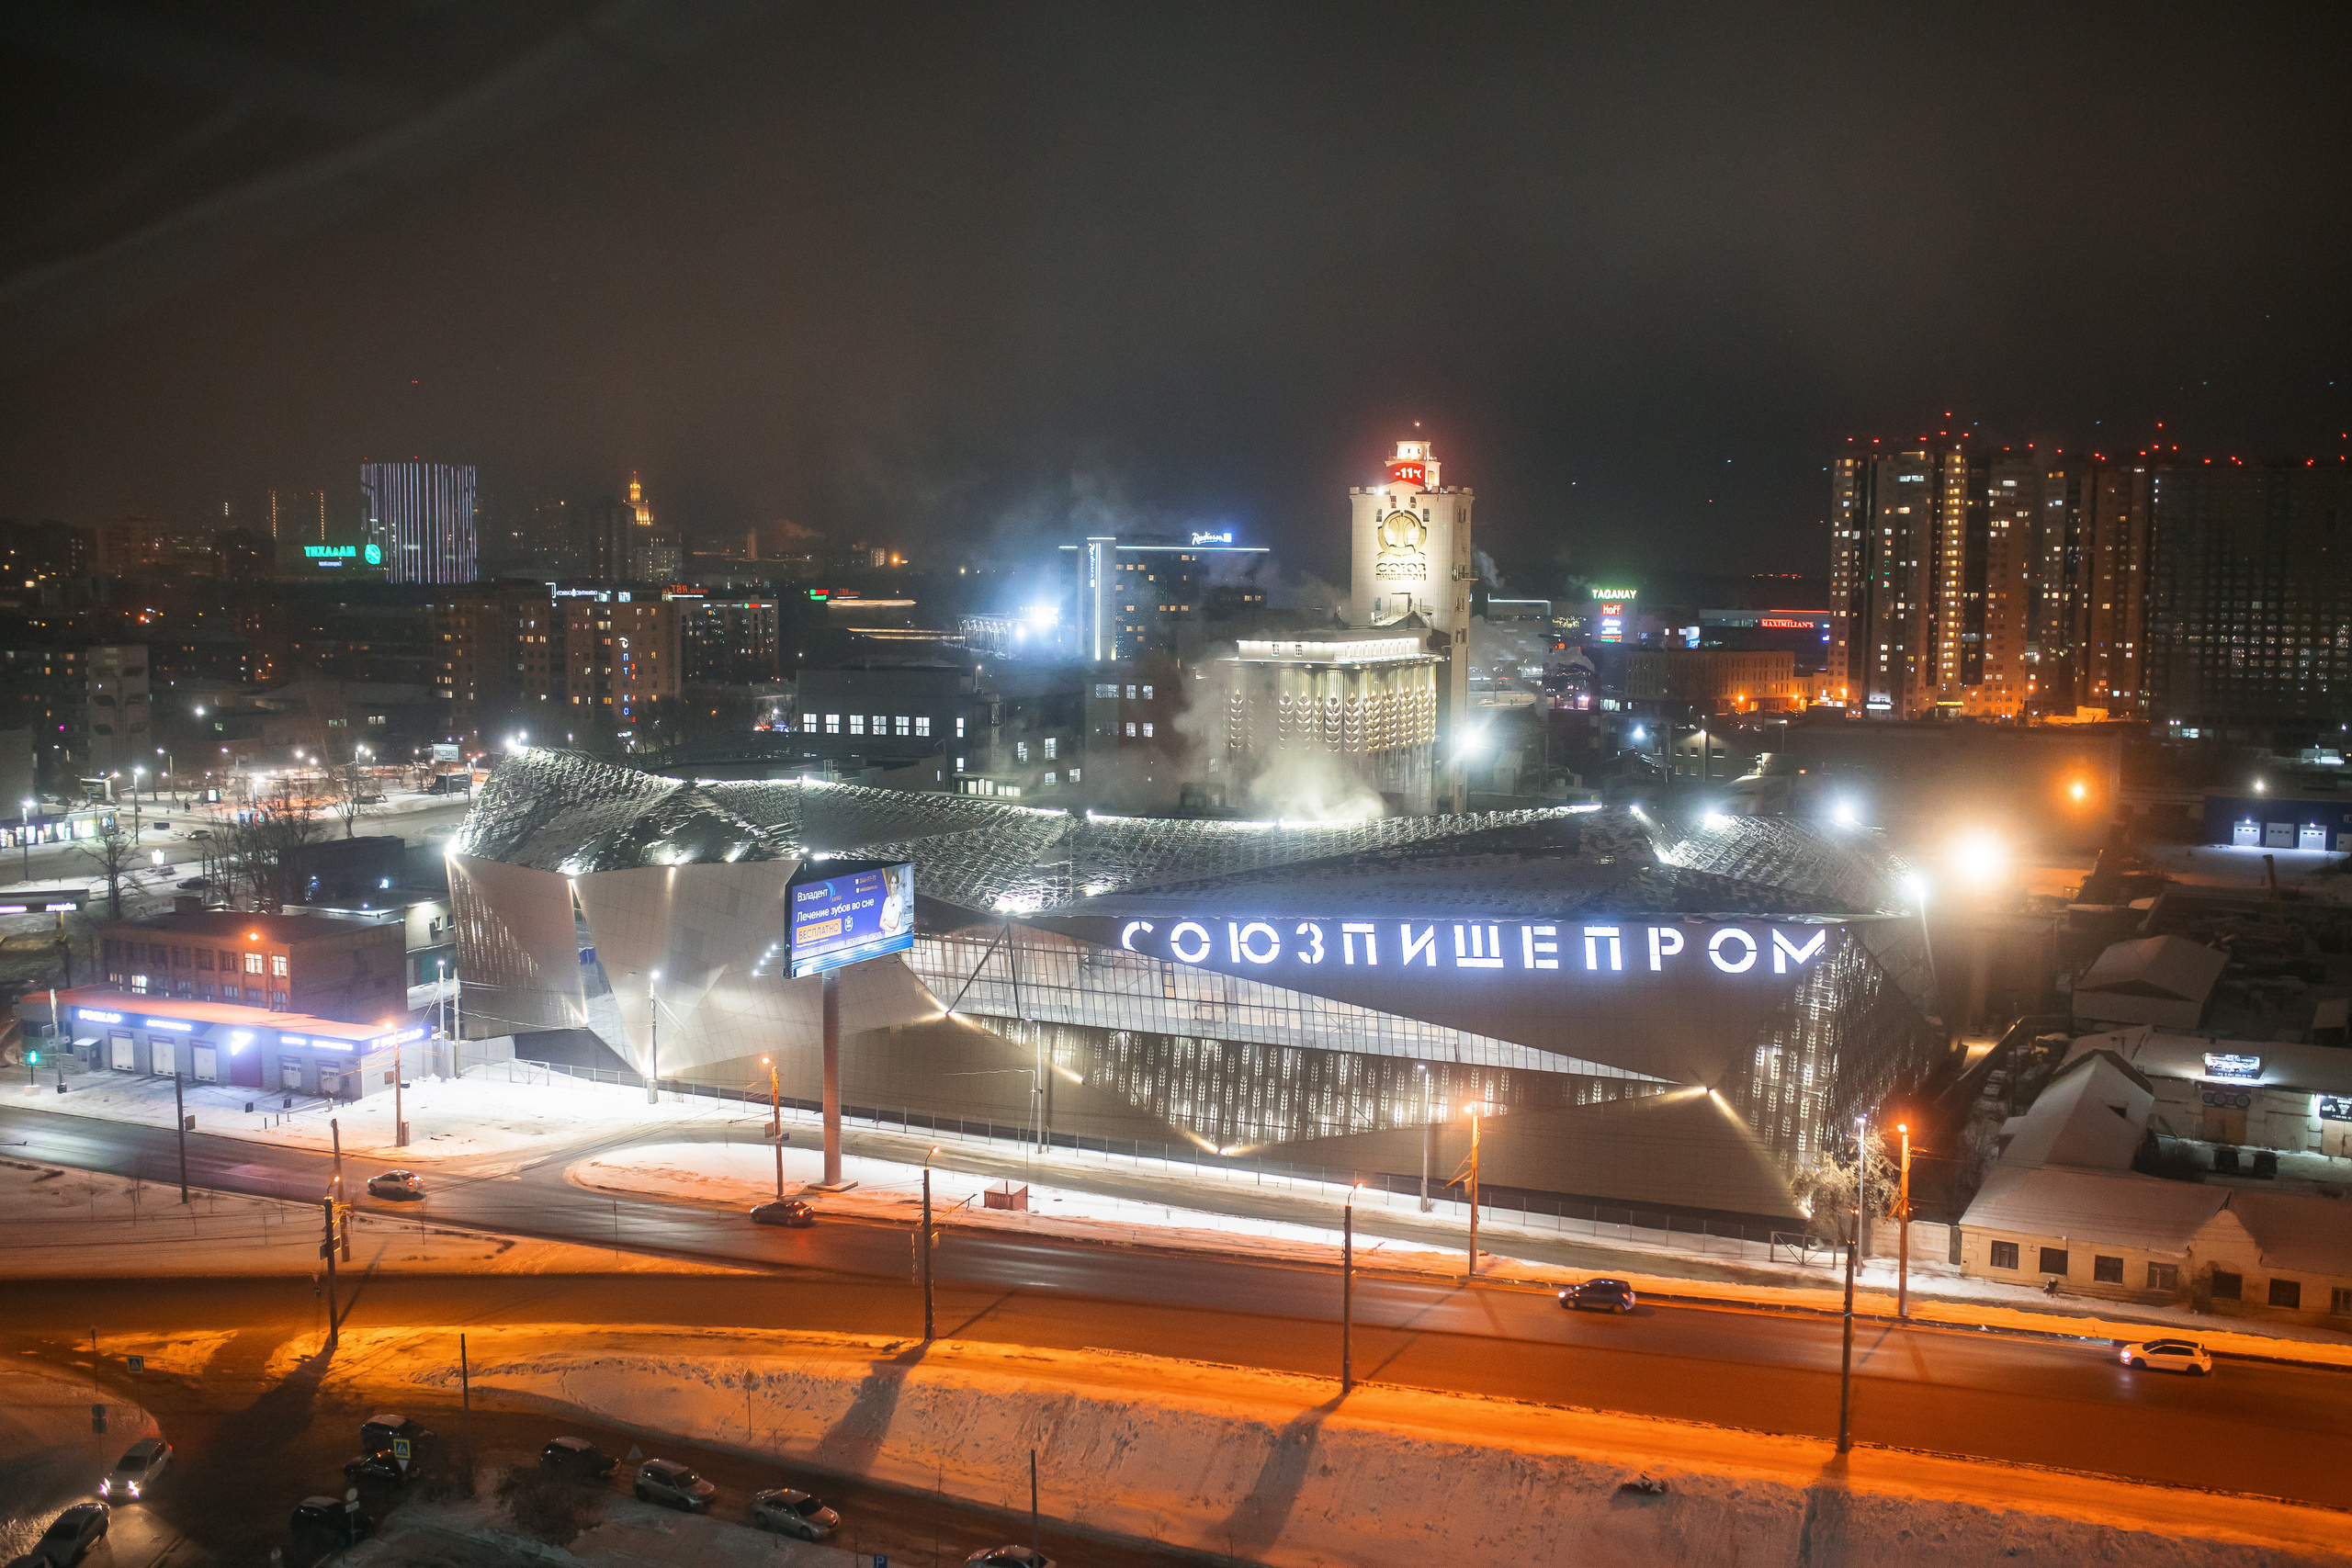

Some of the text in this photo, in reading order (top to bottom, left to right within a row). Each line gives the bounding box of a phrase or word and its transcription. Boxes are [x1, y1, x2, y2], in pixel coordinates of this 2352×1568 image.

[1191, 531, 1224, 546] Radisson
[1591, 589, 1637, 600] TAGANAY
[1602, 604, 1622, 615] Hoff
[1761, 620, 1815, 628] MAXIMILIAN'S
[797, 888, 829, 902] Взладент
[797, 898, 875, 922] Лечение зубов во сне
[1121, 919, 1826, 975] СОЮЗПИЩЕПРОМ
